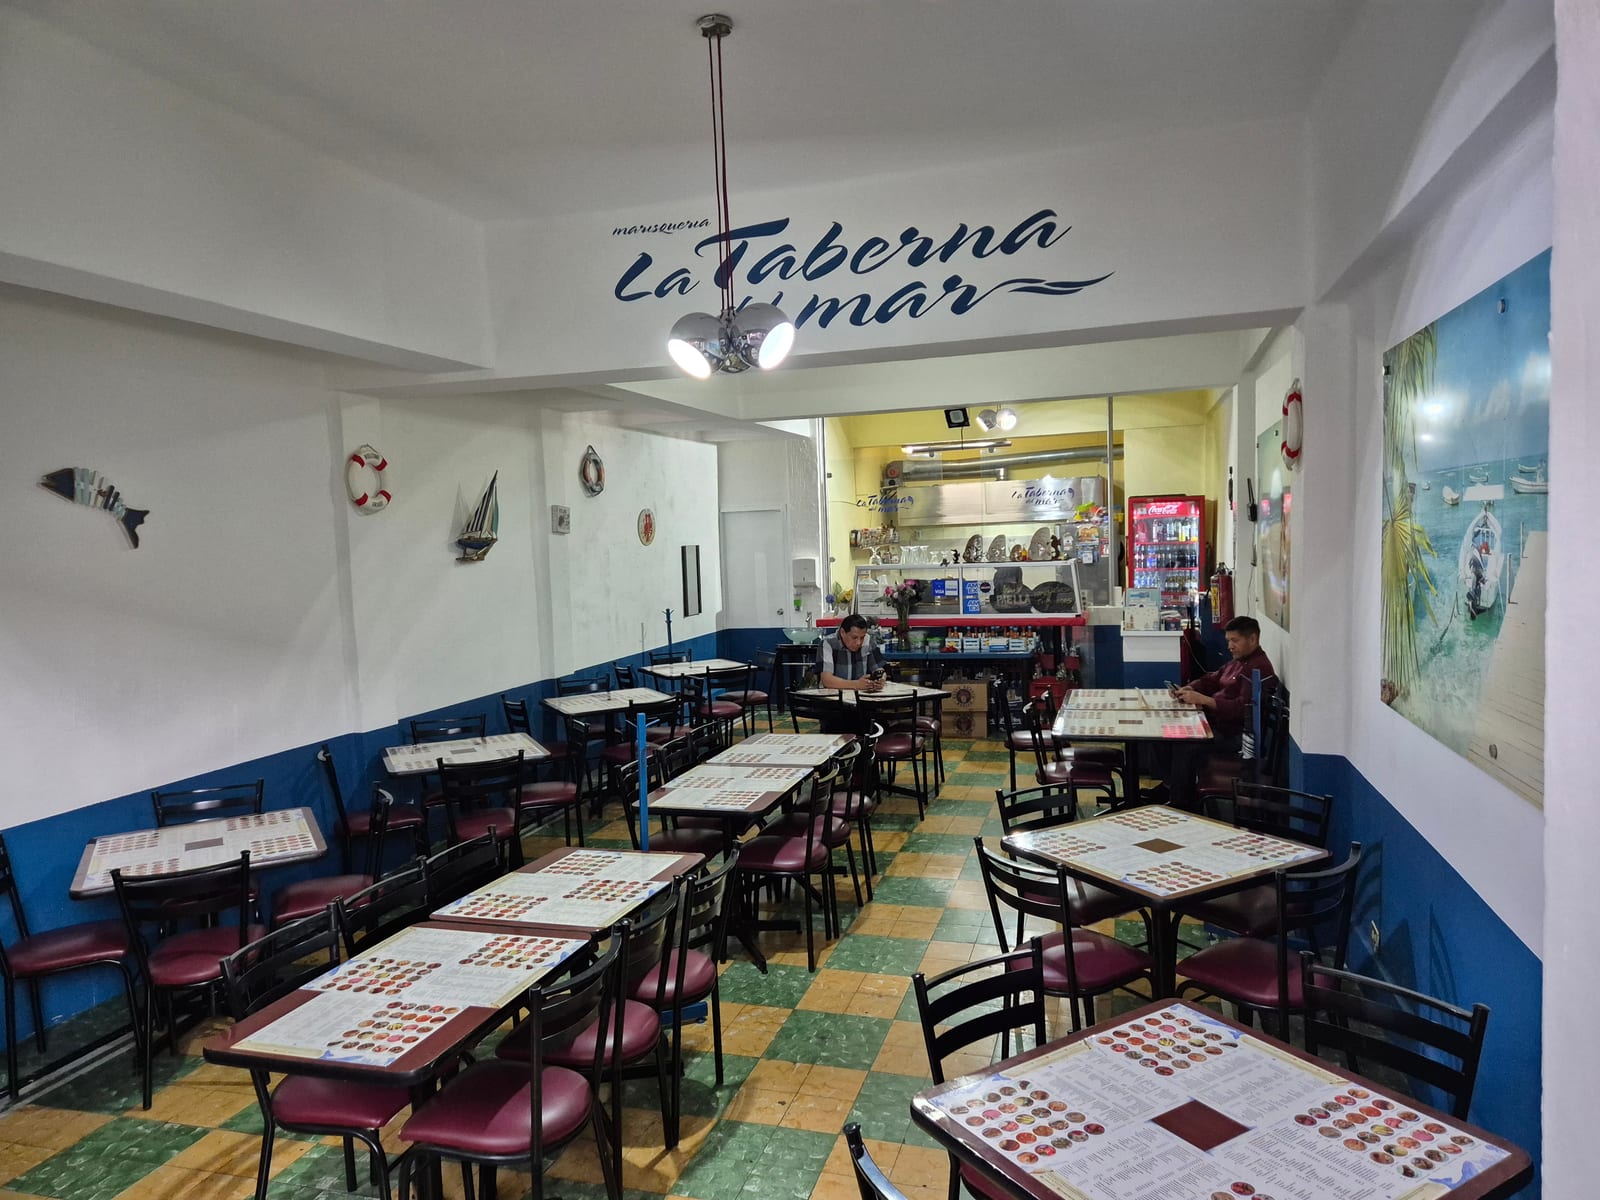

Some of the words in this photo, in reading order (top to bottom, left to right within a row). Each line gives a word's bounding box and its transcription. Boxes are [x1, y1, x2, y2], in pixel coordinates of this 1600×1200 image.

[614, 252, 700, 301] La
[695, 209, 1072, 289] Taberna
[795, 274, 1005, 329] mar
